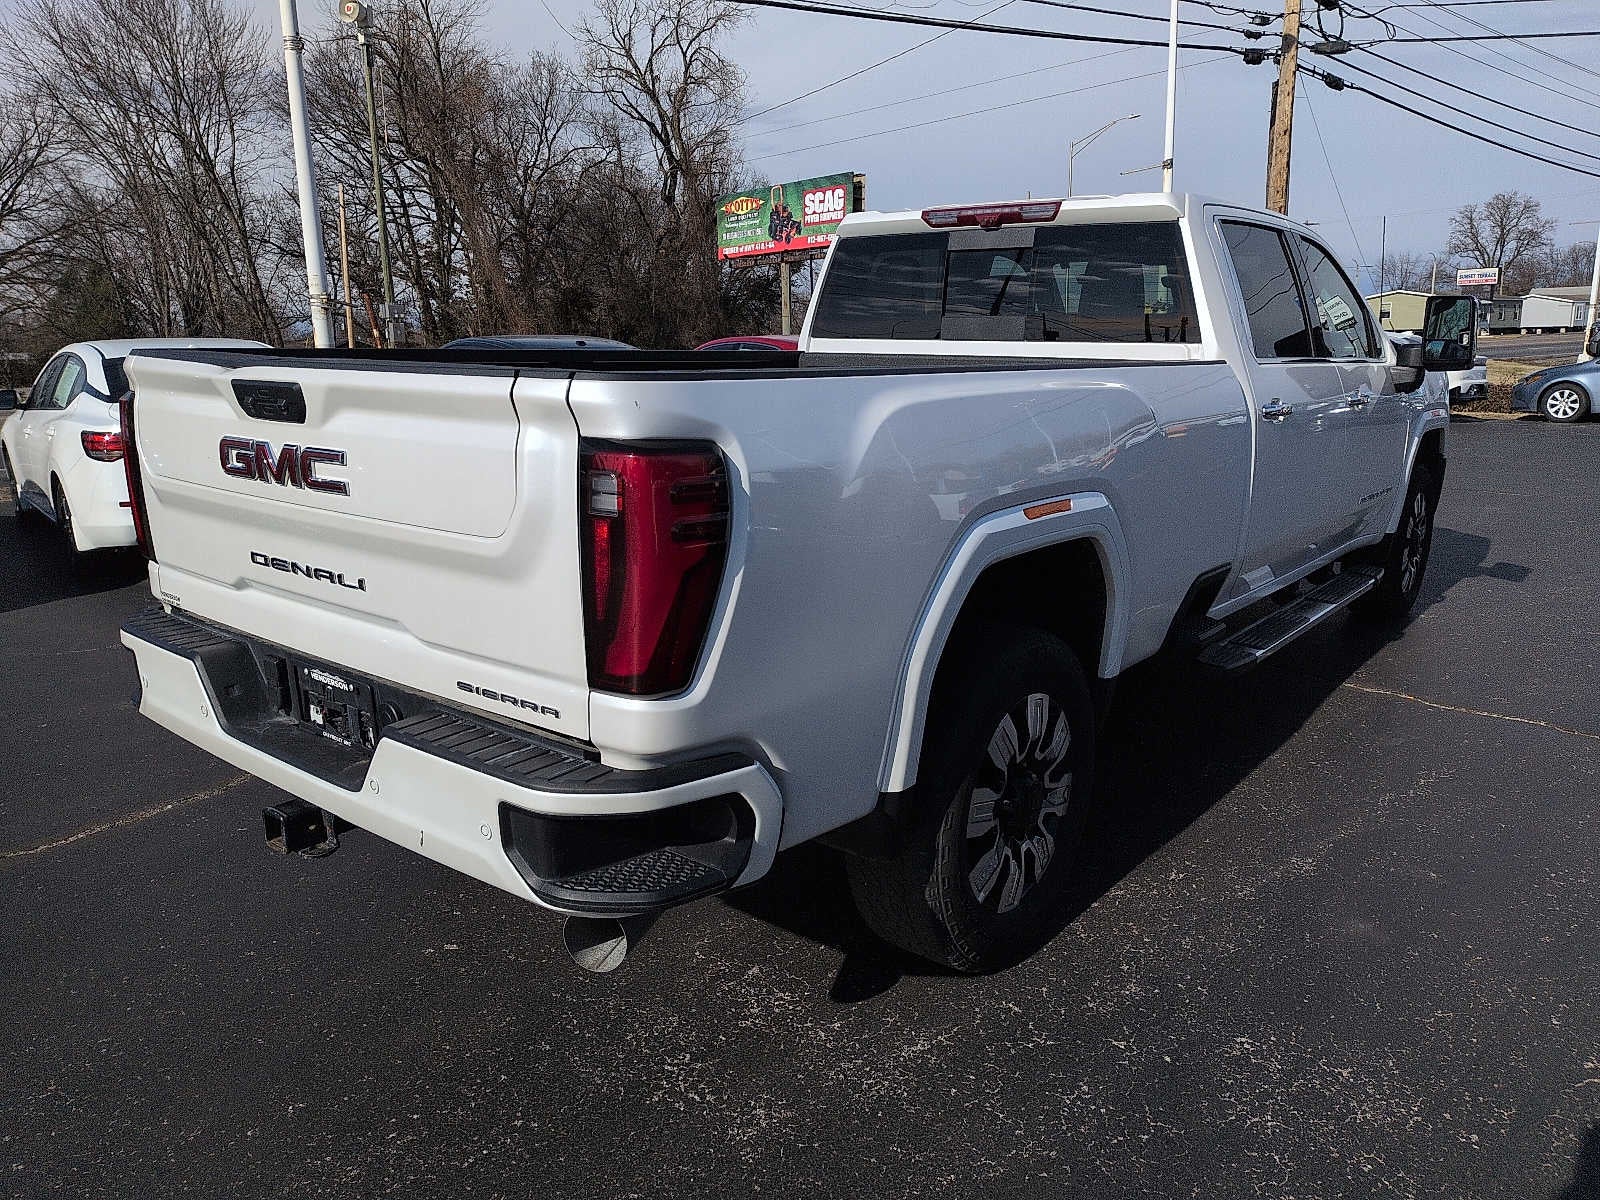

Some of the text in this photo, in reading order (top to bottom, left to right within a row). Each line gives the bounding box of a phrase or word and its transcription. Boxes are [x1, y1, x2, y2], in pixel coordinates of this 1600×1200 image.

[805, 188, 844, 214] SCAG
[219, 435, 350, 496] GMC
[250, 551, 367, 592] DENALI
[310, 671, 349, 692] HENDERSON
[456, 681, 561, 719] SIERRA
